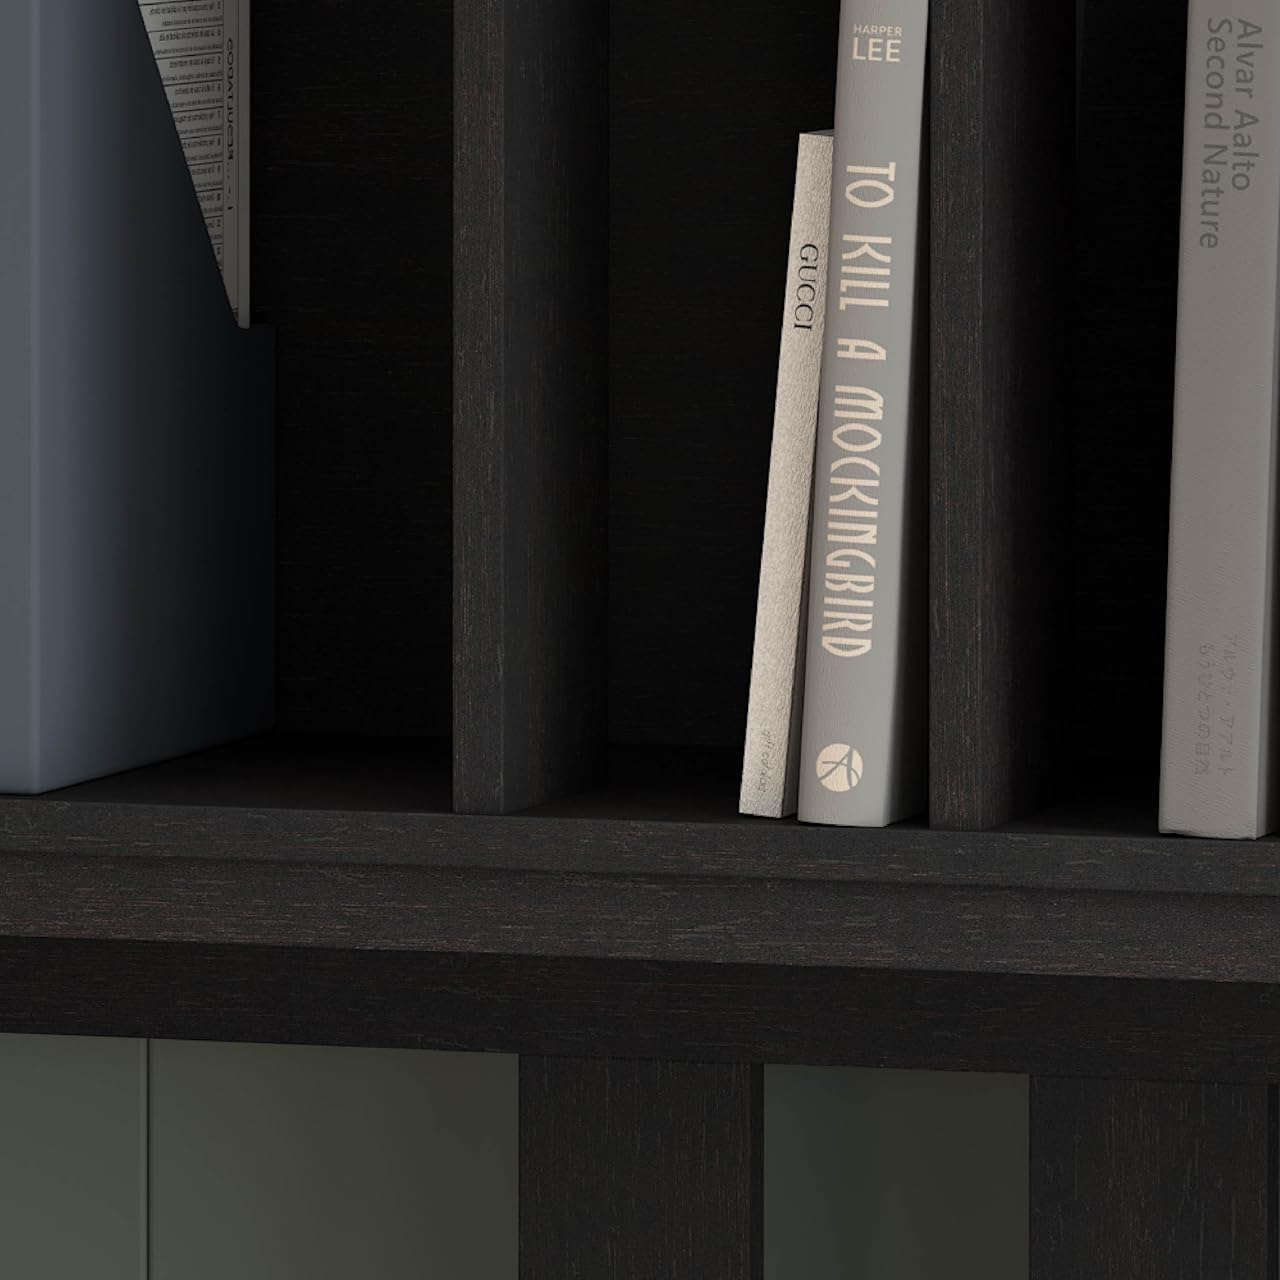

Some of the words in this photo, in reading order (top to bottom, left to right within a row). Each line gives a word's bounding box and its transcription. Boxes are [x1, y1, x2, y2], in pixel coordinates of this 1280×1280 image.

[852, 37, 902, 62] LEE
[853, 24, 903, 37] HARPER
[1236, 18, 1264, 99] Alvar
[1203, 17, 1233, 131] Second
[845, 161, 897, 209] TO
[1231, 109, 1260, 191] Aalto
[1199, 143, 1229, 249] Nature
[793, 243, 820, 331] GUCCI
[839, 233, 893, 311] KILL
[836, 338, 888, 361] A
[821, 384, 885, 658] MOCKINGBIRD
